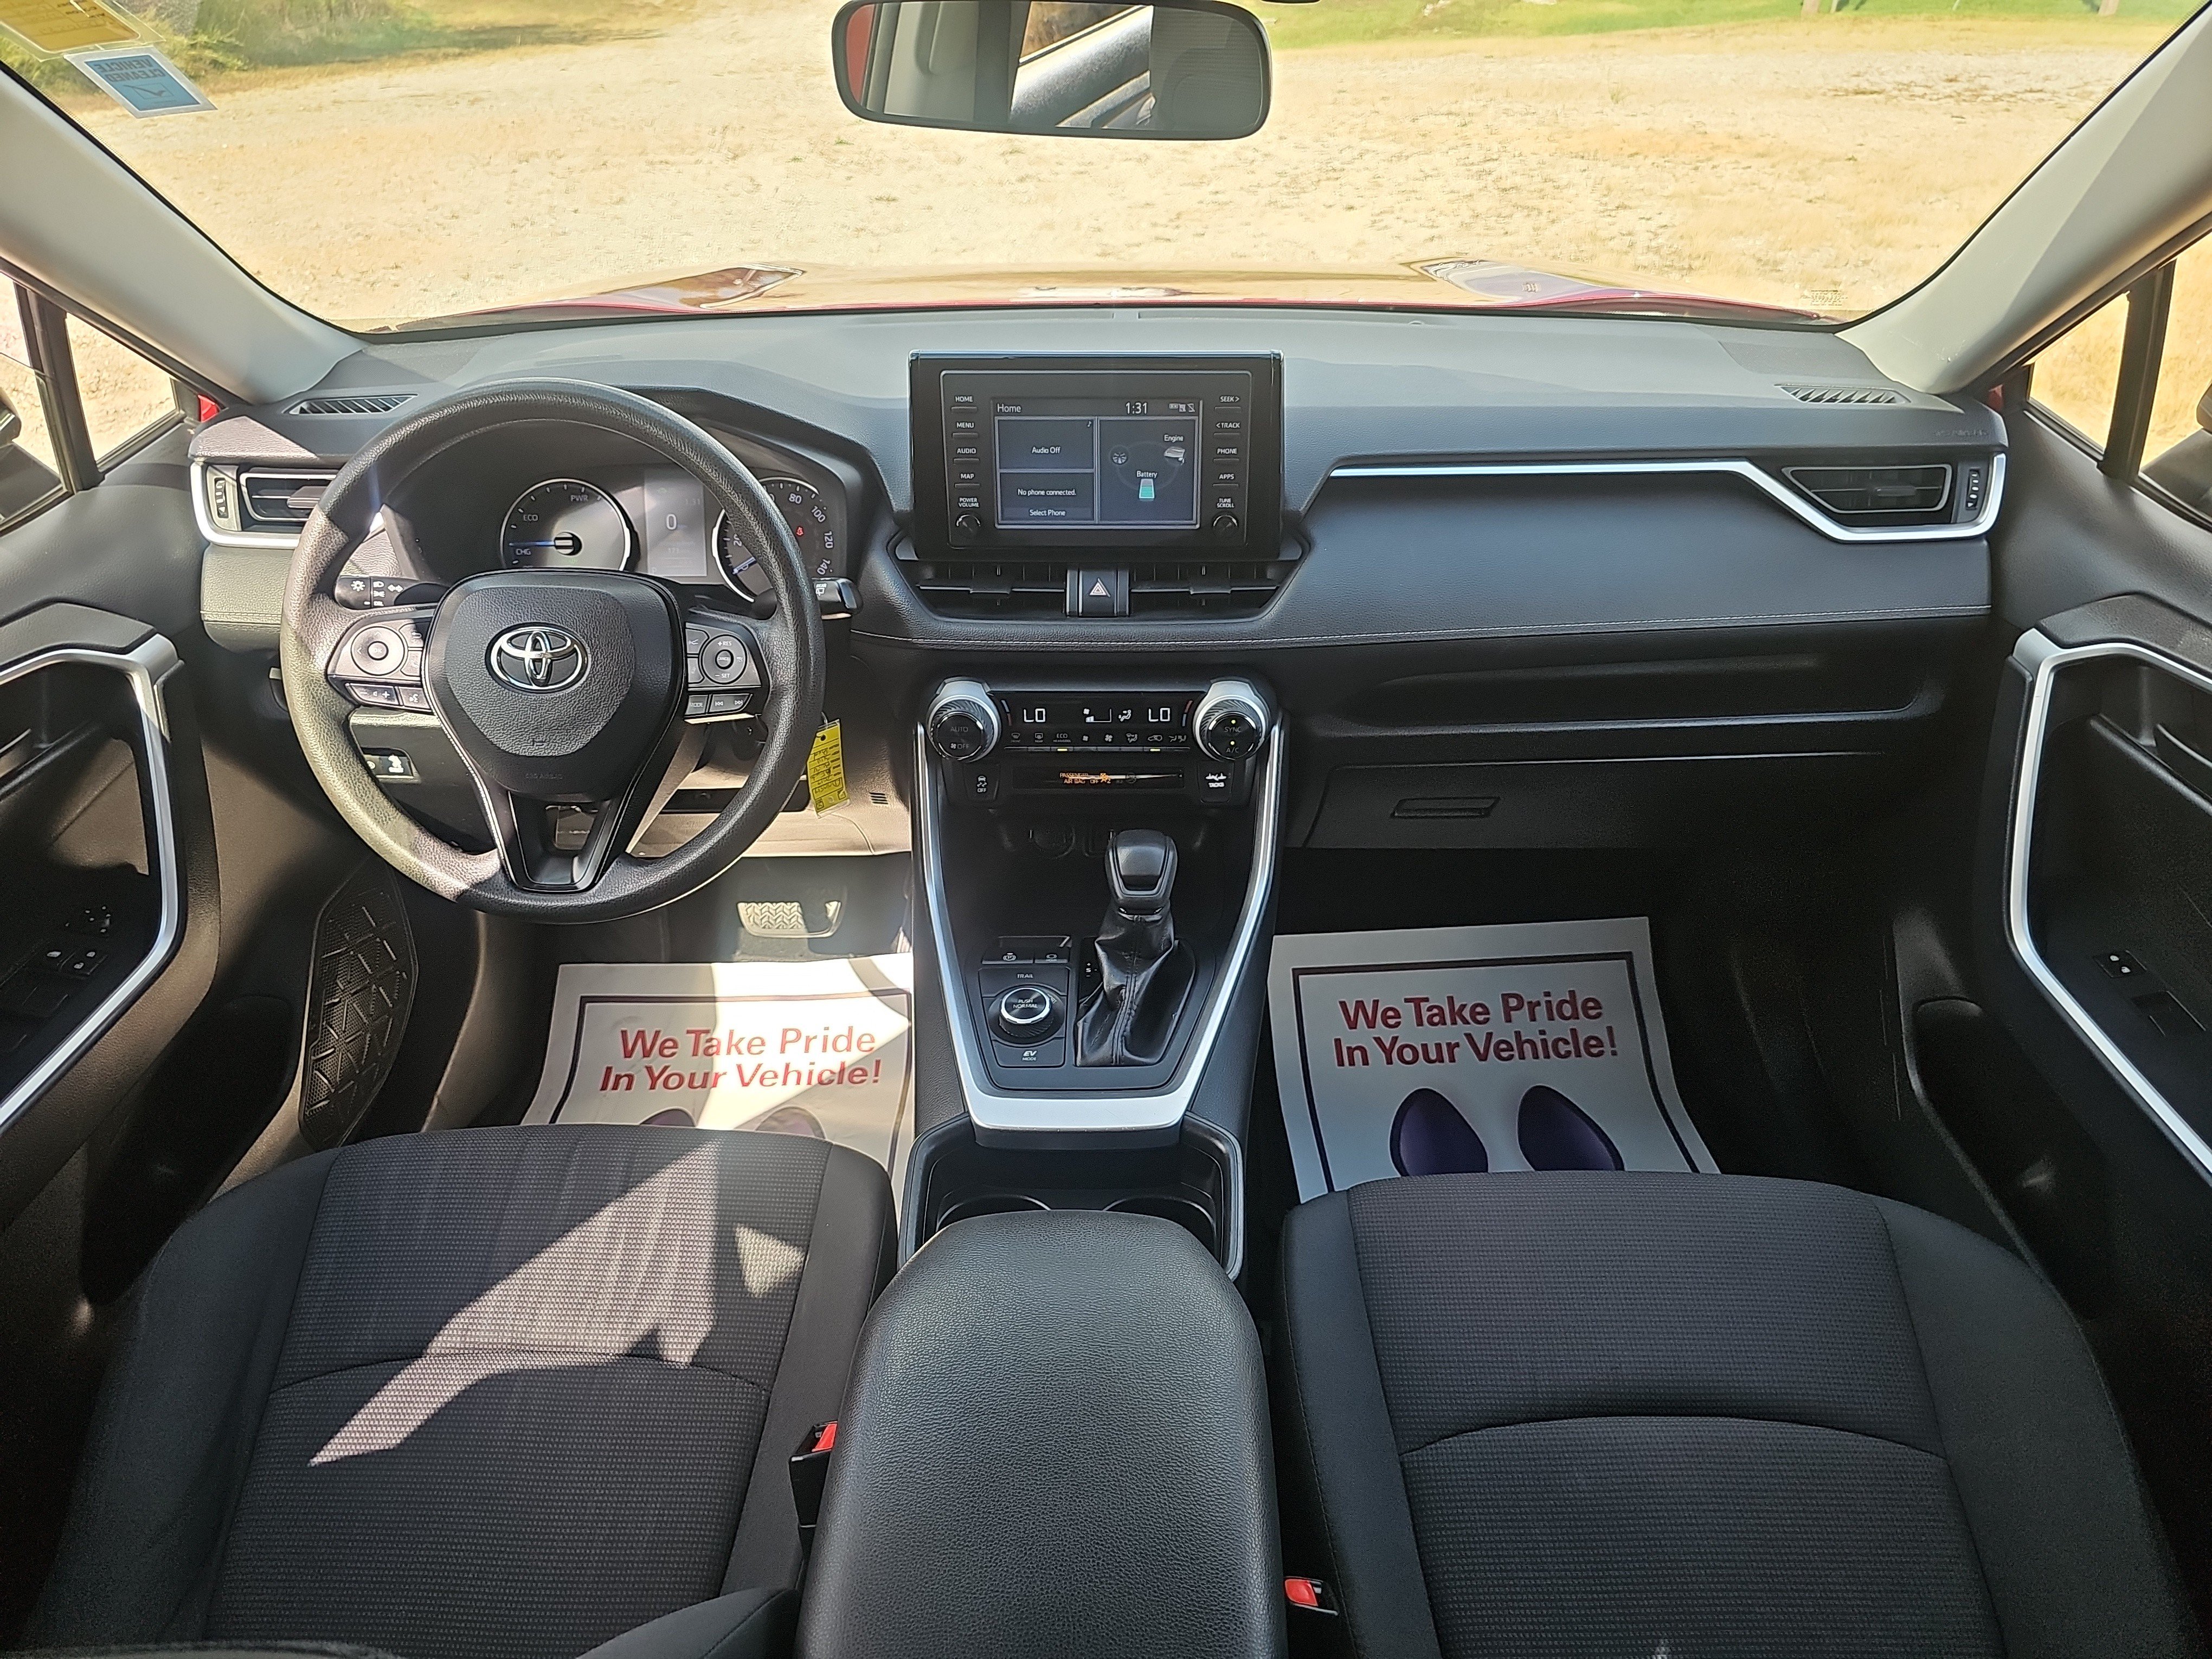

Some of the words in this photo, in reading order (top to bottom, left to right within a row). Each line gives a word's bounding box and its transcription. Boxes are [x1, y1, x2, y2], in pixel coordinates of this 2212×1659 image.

[996, 403, 1021, 413] Home
[1126, 402, 1148, 414] 1:31
[570, 494, 588, 502] PWR
[789, 493, 802, 504] 80
[666, 513, 678, 530] 0
[811, 505, 826, 523] 100
[824, 531, 833, 549] 120
[816, 558, 831, 575] 140
[1024, 708, 1046, 723] LO
[1148, 708, 1171, 722] LO
[1338, 999, 1401, 1030] We
[1404, 995, 1490, 1027] Take
[1500, 989, 1603, 1023] Pride
[620, 1029, 679, 1059] We
[686, 1029, 766, 1057] Take
[779, 1026, 876, 1053] Pride
[1334, 1037, 1369, 1067] In
[1373, 1034, 1460, 1066] Your
[1463, 1025, 1618, 1063] Vehicle!
[599, 1065, 635, 1092] In
[644, 1063, 727, 1091] Your
[735, 1058, 882, 1088] Vehicle!
